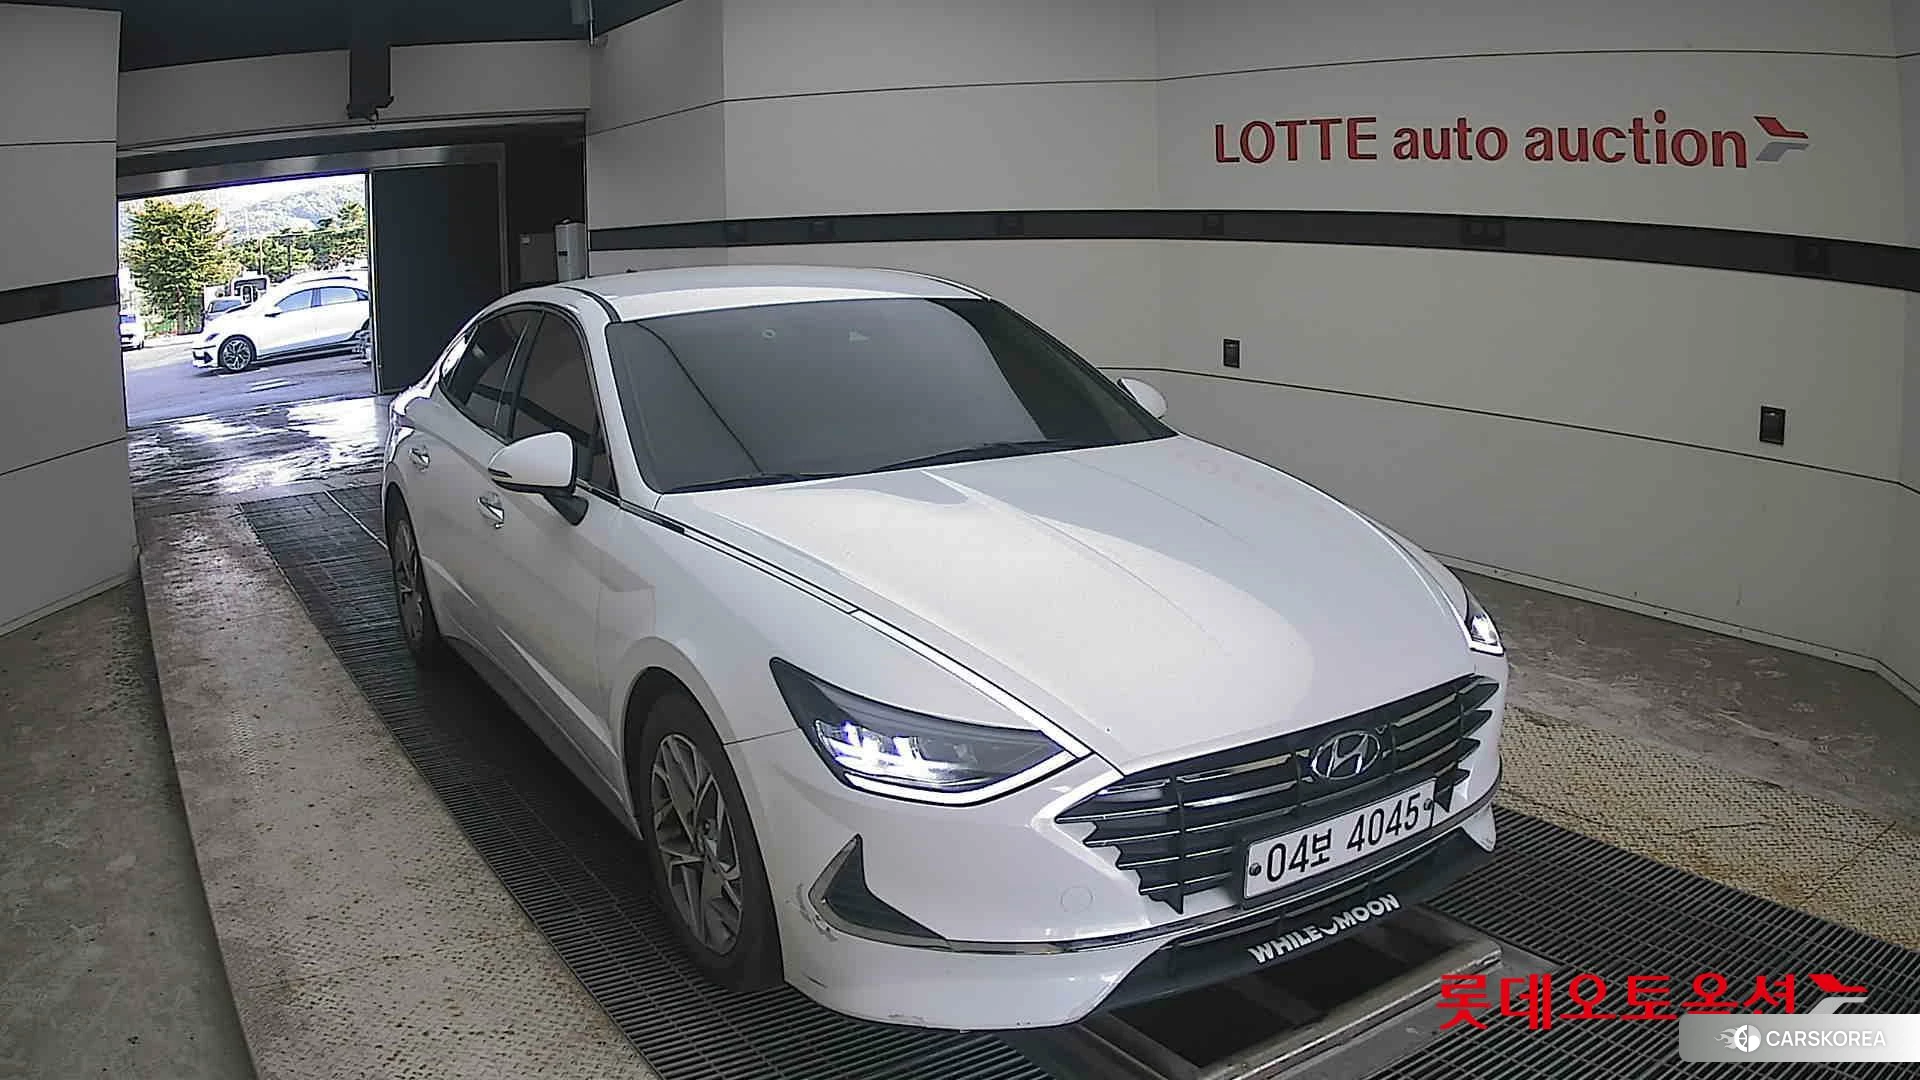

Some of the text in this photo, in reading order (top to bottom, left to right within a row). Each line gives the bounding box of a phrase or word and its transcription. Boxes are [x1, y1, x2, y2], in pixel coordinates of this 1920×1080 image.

[1214, 109, 1748, 168] LOTTE auto auction
[1266, 792, 1421, 882] 04보 4045
[1248, 893, 1401, 964] WHILE MOON
